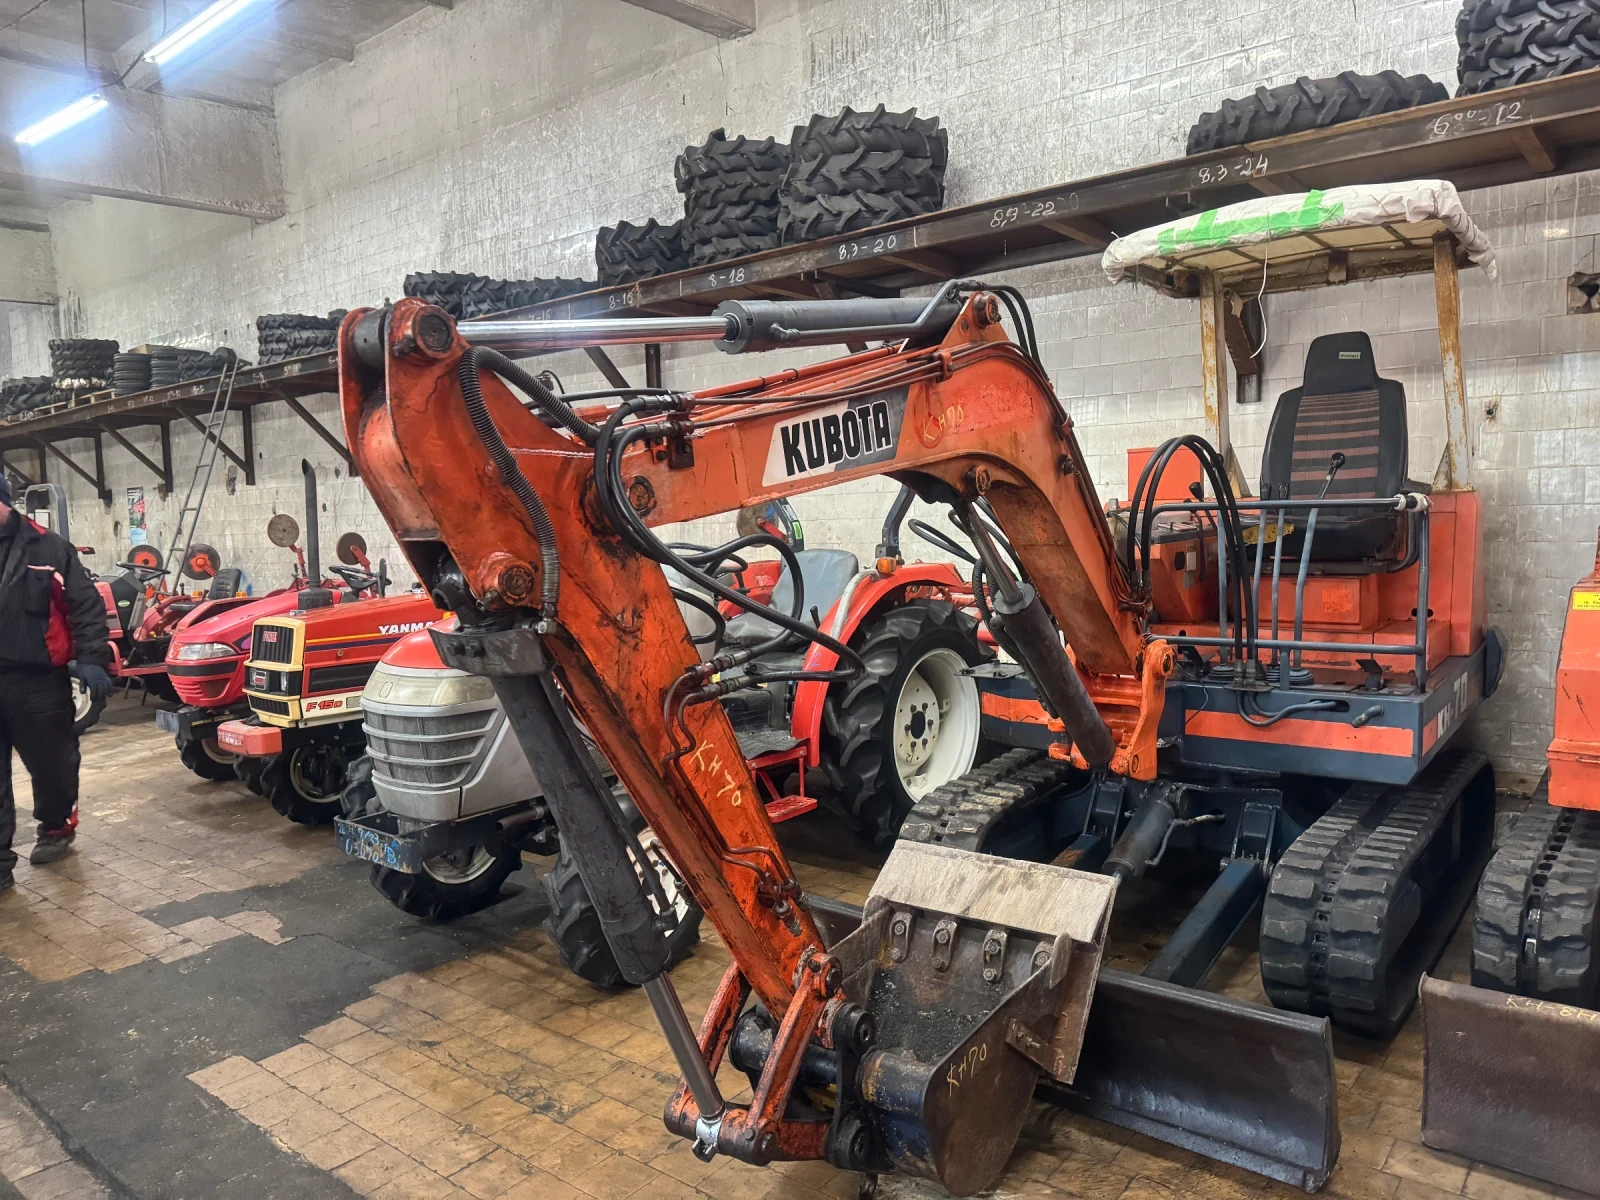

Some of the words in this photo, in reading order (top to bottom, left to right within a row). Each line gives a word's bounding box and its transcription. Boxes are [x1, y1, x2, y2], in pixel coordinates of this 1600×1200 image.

[1198, 153, 1268, 184] 8,3-24
[839, 235, 897, 260] 8,3-20
[708, 267, 745, 287] 8-18
[780, 400, 893, 478] KUBOTA
[378, 621, 435, 636] YANMA
[689, 739, 742, 807] KH70
[946, 1043, 987, 1097] KH70
